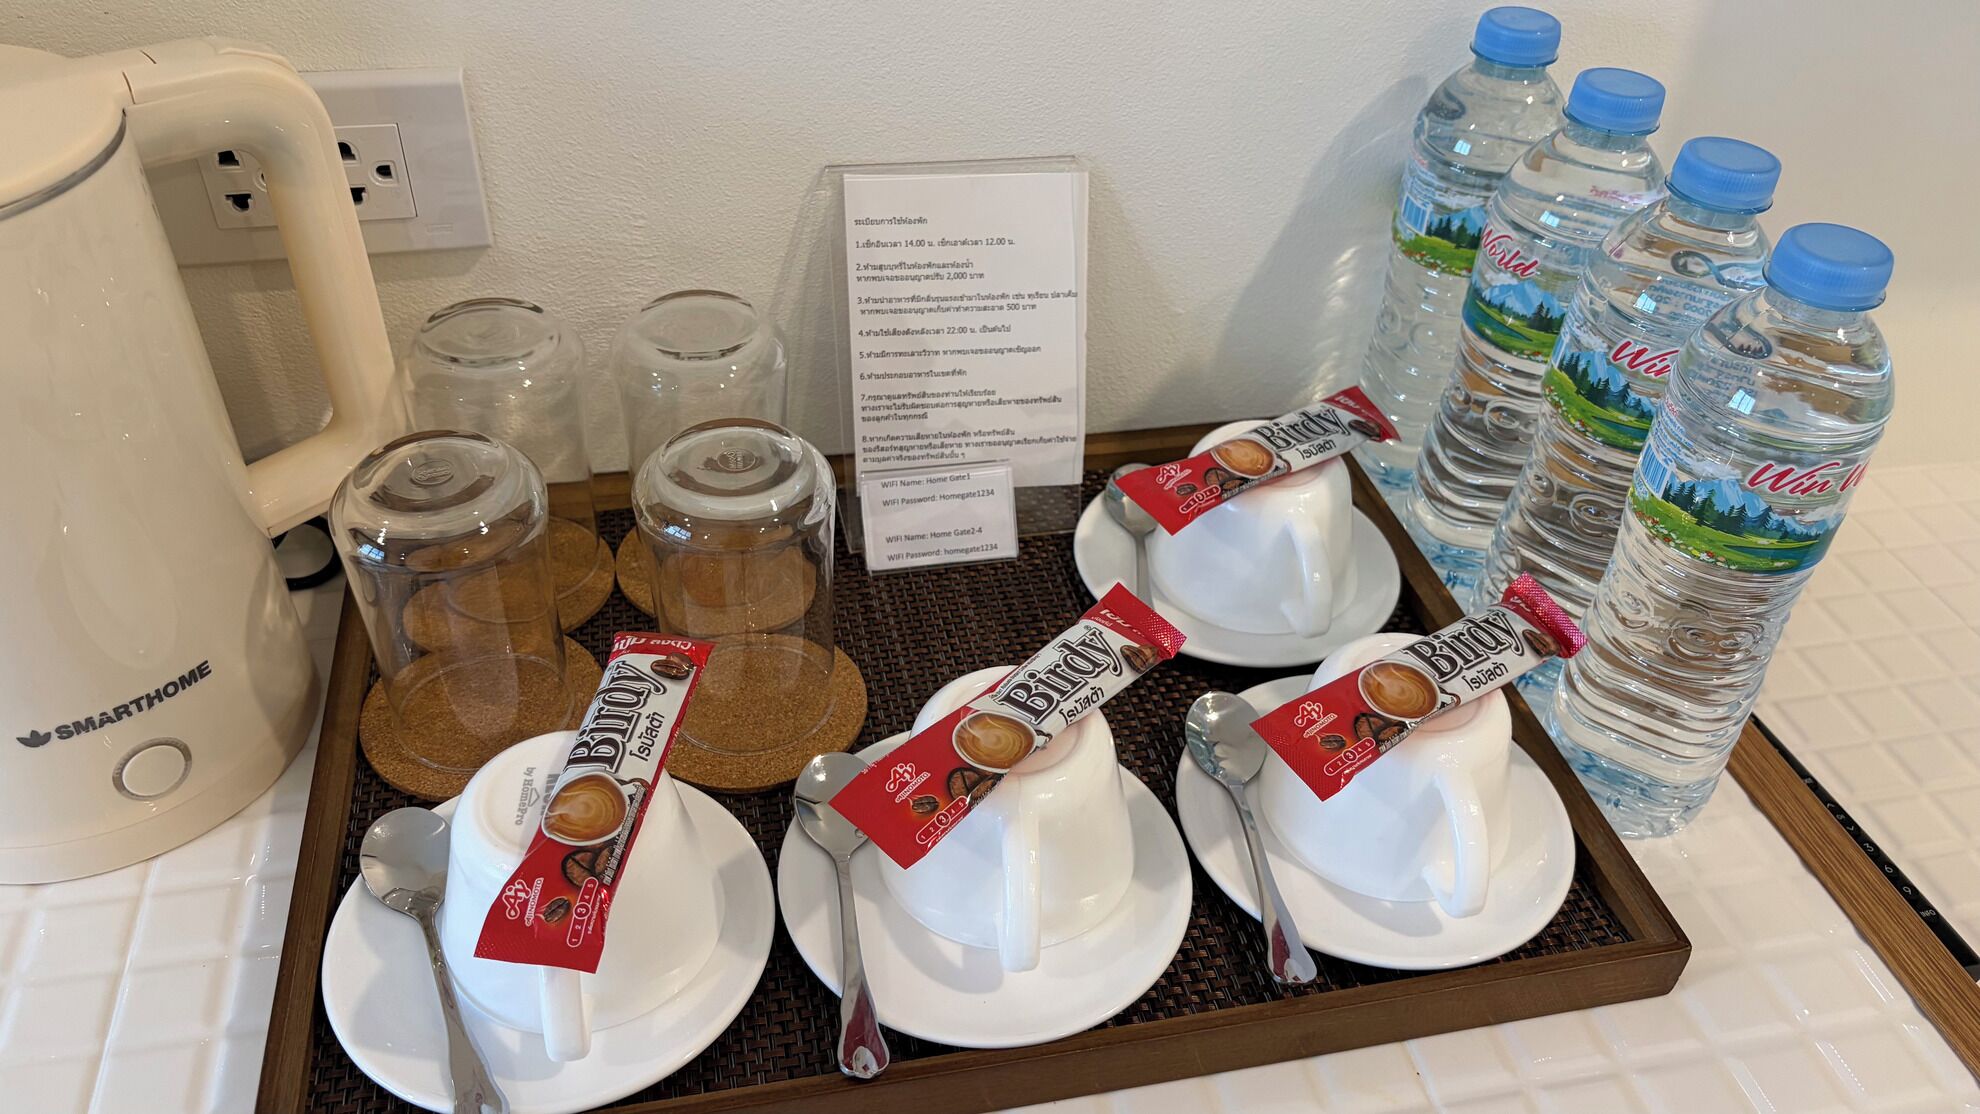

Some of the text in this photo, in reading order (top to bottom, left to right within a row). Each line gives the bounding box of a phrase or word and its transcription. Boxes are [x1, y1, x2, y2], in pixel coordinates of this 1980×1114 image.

[905, 240, 926, 248] 14.00
[986, 238, 1006, 246] 12.00
[1482, 223, 1538, 277] World
[947, 272, 967, 281] 2,000
[1006, 303, 1019, 311] 500
[947, 326, 967, 335] 22:00
[1254, 406, 1350, 450] Birdy
[1298, 438, 1336, 460] โรบัสต้า
[881, 480, 898, 489] WIFI
[900, 478, 924, 487] Name:
[949, 473, 970, 482] Gate1
[1748, 462, 1840, 496] Win
[883, 489, 995, 507] WIFI Password: Homegate1234
[904, 533, 928, 542] Name:
[954, 527, 983, 537] Gate2-4
[887, 543, 998, 562] WIFI Password: homegate1234
[1403, 610, 1524, 682] Birdy
[995, 625, 1122, 726] Birdy
[1462, 662, 1509, 692] โรบัสต้า
[55, 660, 212, 740] SMARTHOME
[1059, 686, 1106, 726] โรบัสต้า
[564, 660, 667, 774] Birdy
[630, 712, 665, 762] โรบัสต้า
[1346, 751, 1354, 760] 3
[515, 767, 536, 826] by HomePro
[939, 814, 946, 824] 3
[1864, 842, 1874, 852] 3
[1884, 865, 1893, 874] 6
[1903, 886, 1912, 895] 9
[577, 907, 586, 915] 3
